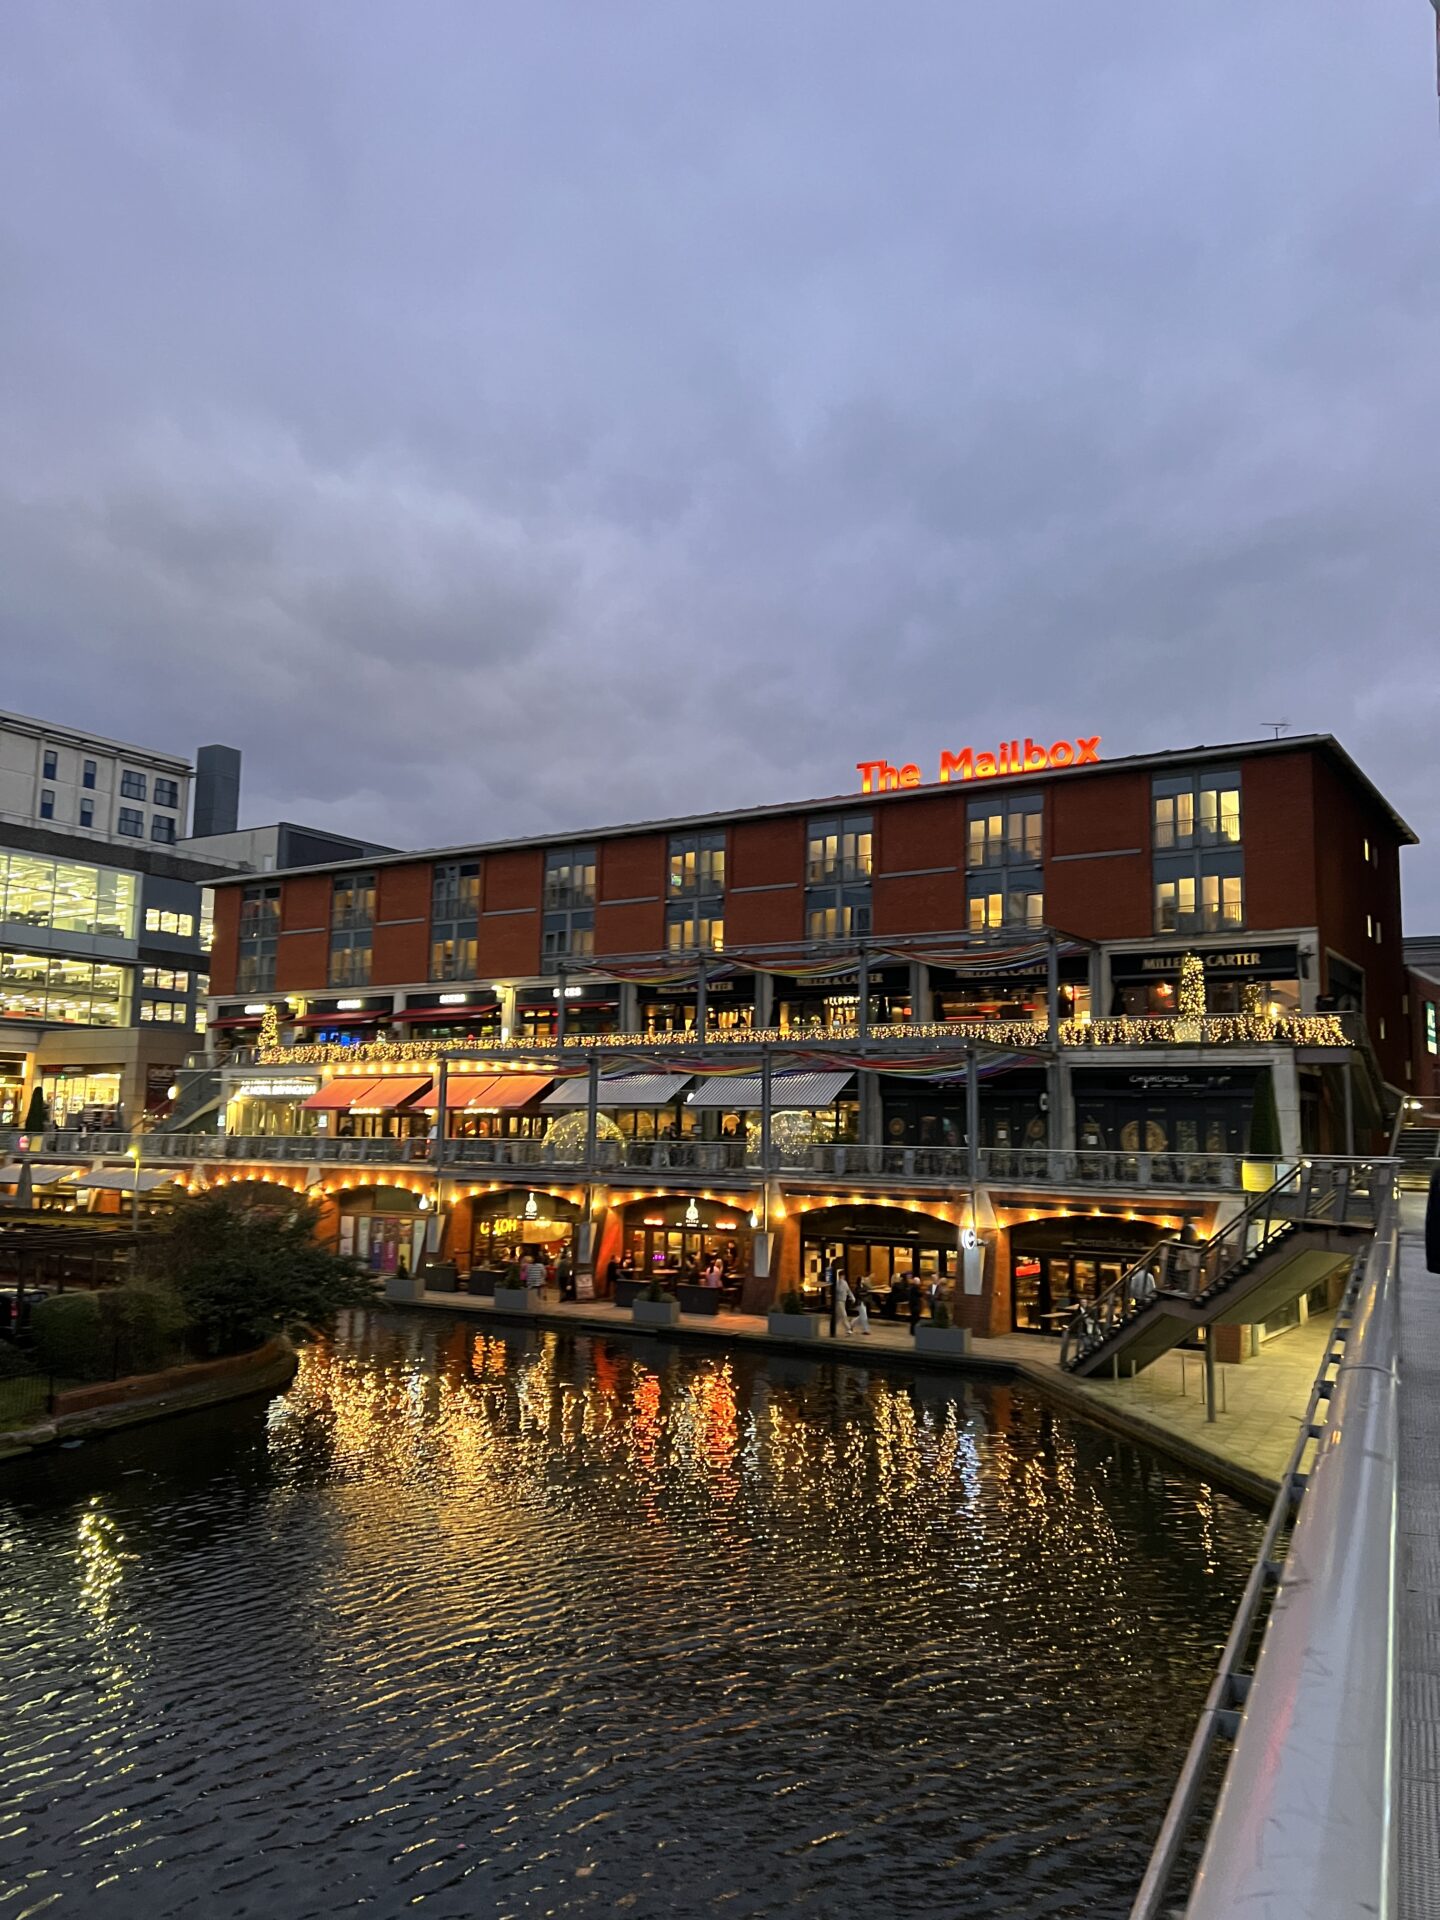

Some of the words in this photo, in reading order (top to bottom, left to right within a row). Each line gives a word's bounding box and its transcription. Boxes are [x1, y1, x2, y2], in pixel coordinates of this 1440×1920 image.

[856, 760, 921, 794] The
[939, 735, 1102, 784] Mailbox
[1141, 957, 1186, 970] MILLE
[1206, 952, 1261, 966] CARTER
[1011, 963, 1049, 976] CARTE
[842, 972, 884, 984] CATER
[704, 981, 734, 992] ARTER
